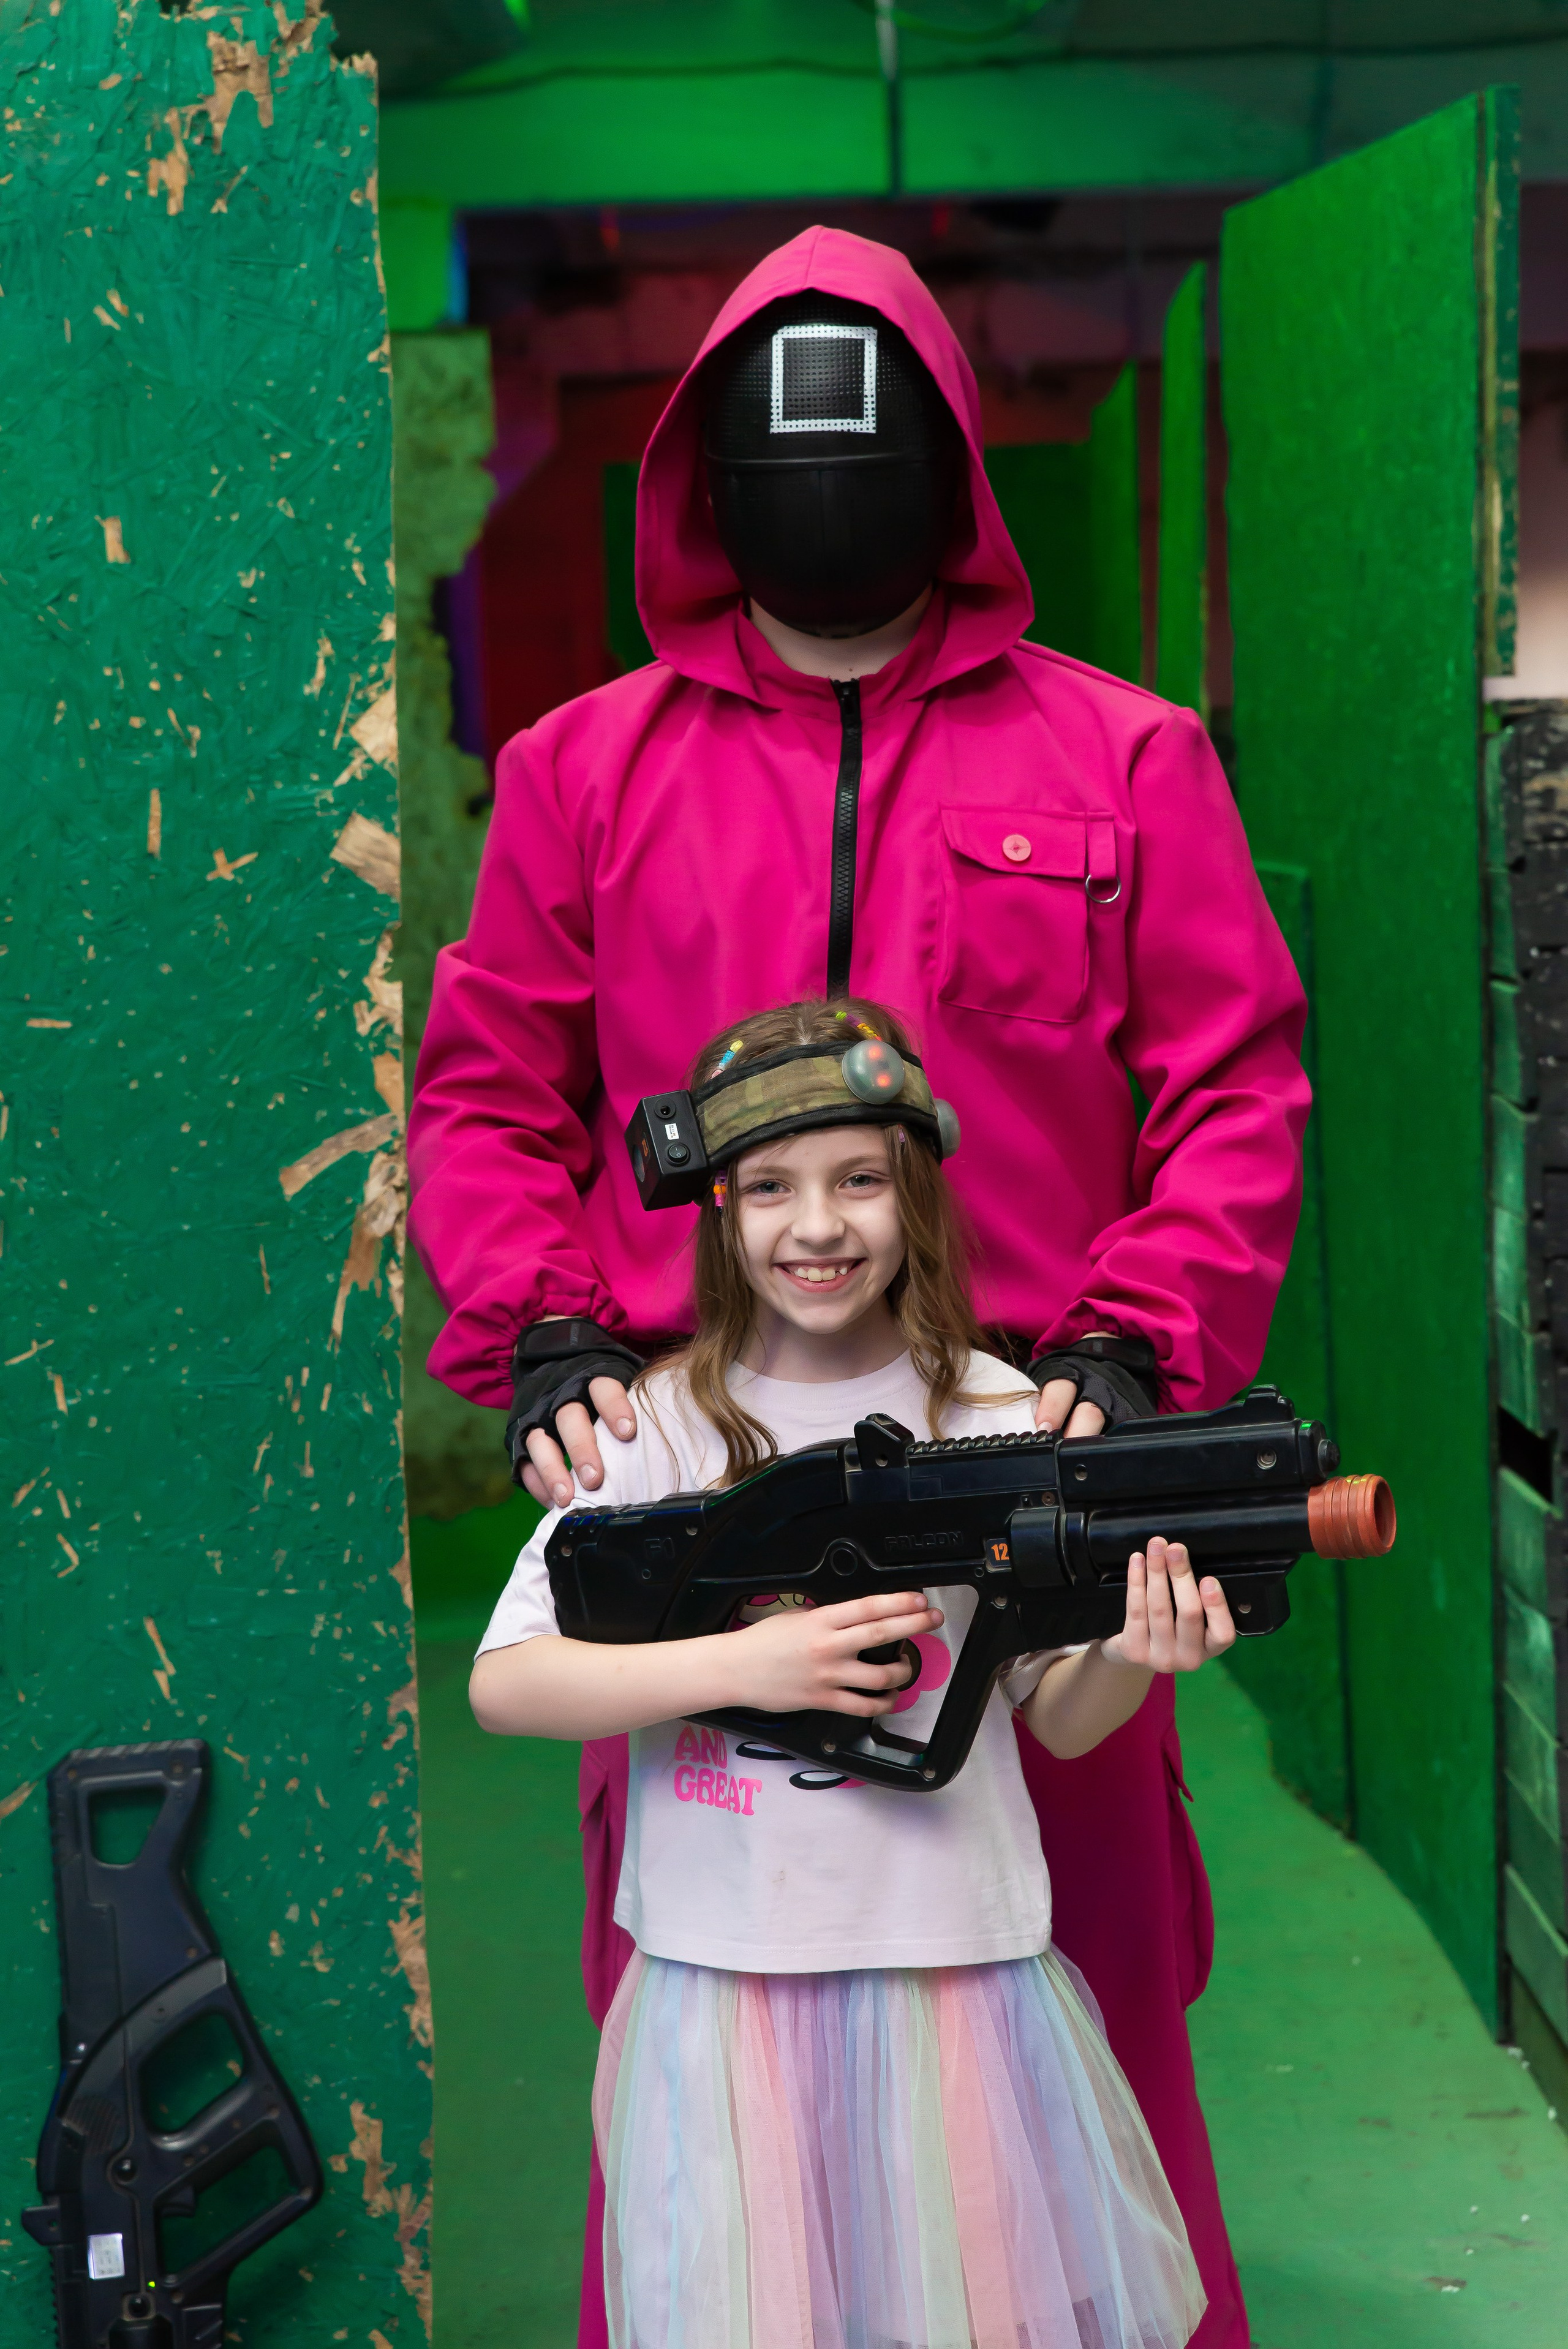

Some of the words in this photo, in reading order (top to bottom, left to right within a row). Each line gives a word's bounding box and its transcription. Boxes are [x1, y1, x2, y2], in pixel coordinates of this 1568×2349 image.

[885, 1531, 963, 1552] FALCON
[991, 1543, 1009, 1561] 12
[674, 1723, 728, 1770] AND
[674, 1765, 763, 1816] GREAT
